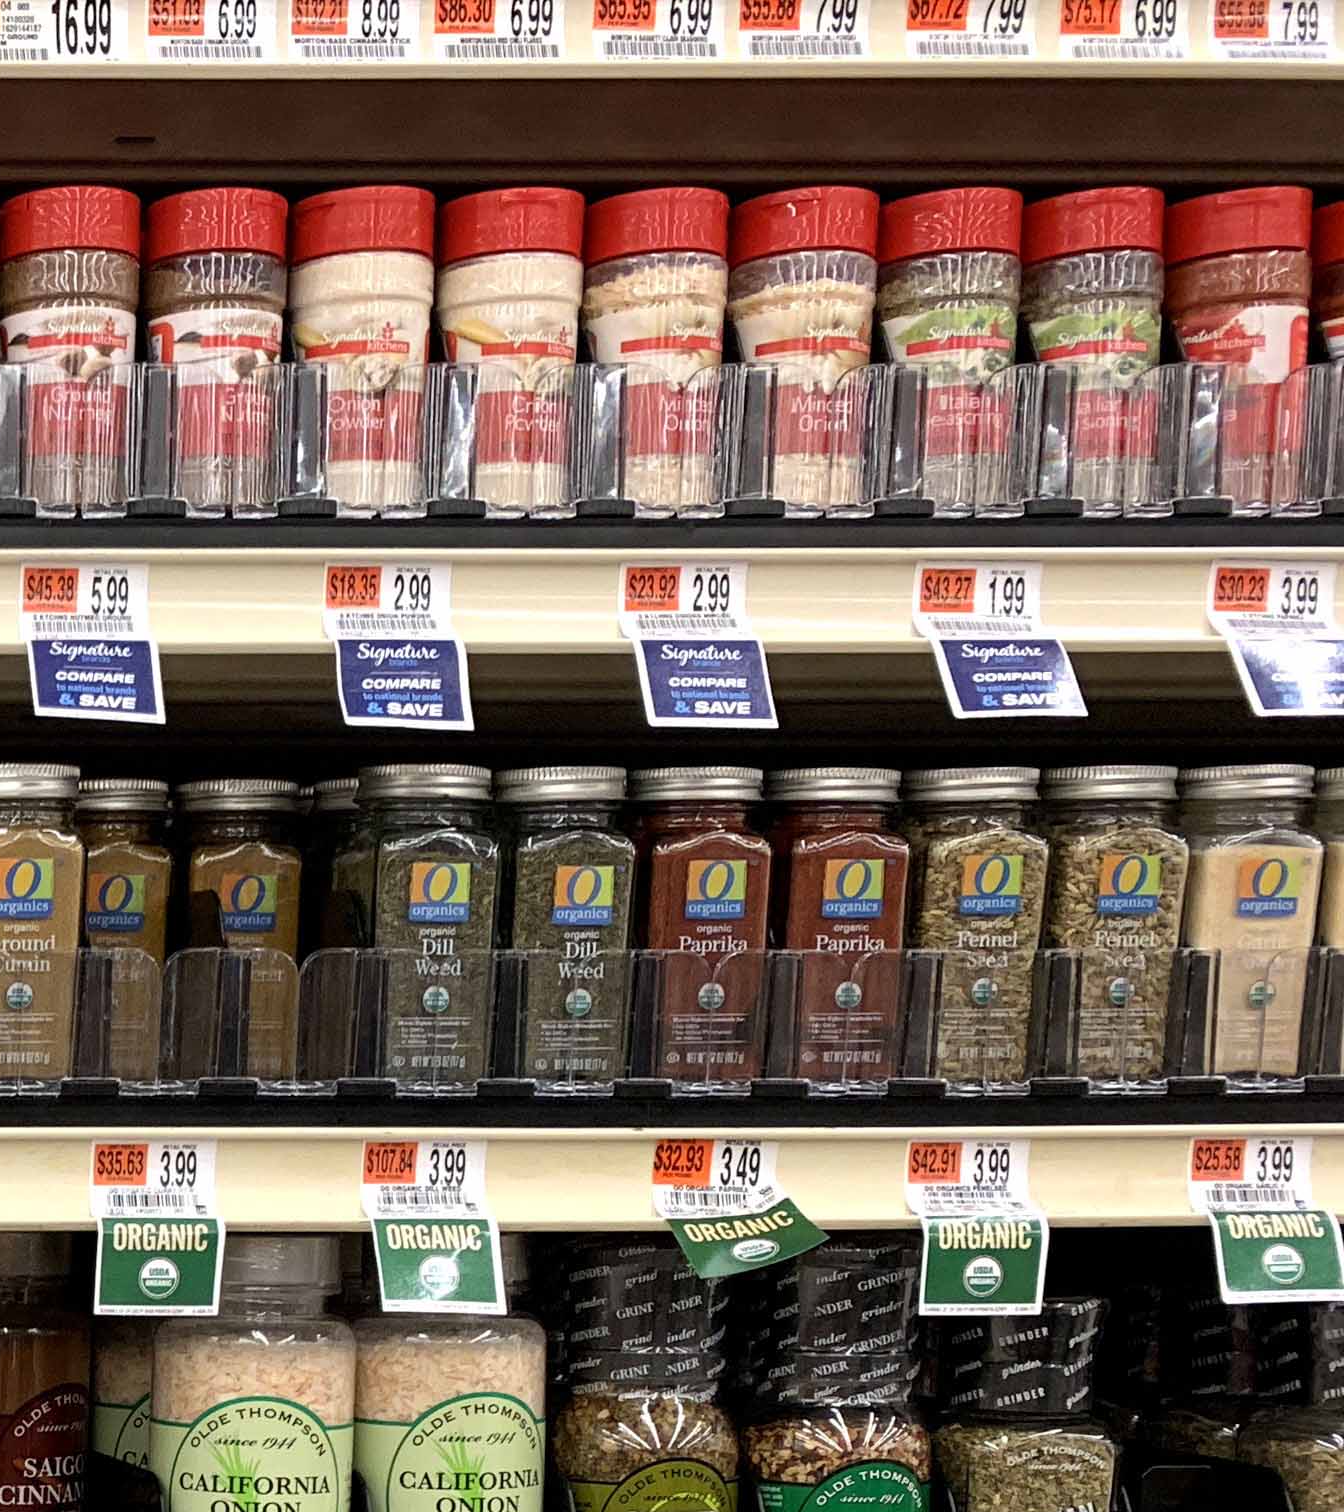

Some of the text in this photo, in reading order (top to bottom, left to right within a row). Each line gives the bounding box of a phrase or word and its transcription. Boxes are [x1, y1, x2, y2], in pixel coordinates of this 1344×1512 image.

[51, 0, 111, 55] 16.99
[27, 574, 129, 616] $45.38 5.99
[924, 575, 1026, 615] $43.27 1.99
[422, 939, 454, 956] Dill
[679, 935, 747, 953] Paprika
[957, 931, 1018, 947] Fennel
[367, 1148, 465, 1186] $107.84 3.99
[912, 1148, 1010, 1185] $42.91 3.99
[684, 1211, 794, 1244] ORGANIC
[189, 1407, 327, 1457] OLDE THOMPSON
[213, 1434, 296, 1450] since 1944
[179, 1472, 330, 1495] CALIFORNIA
